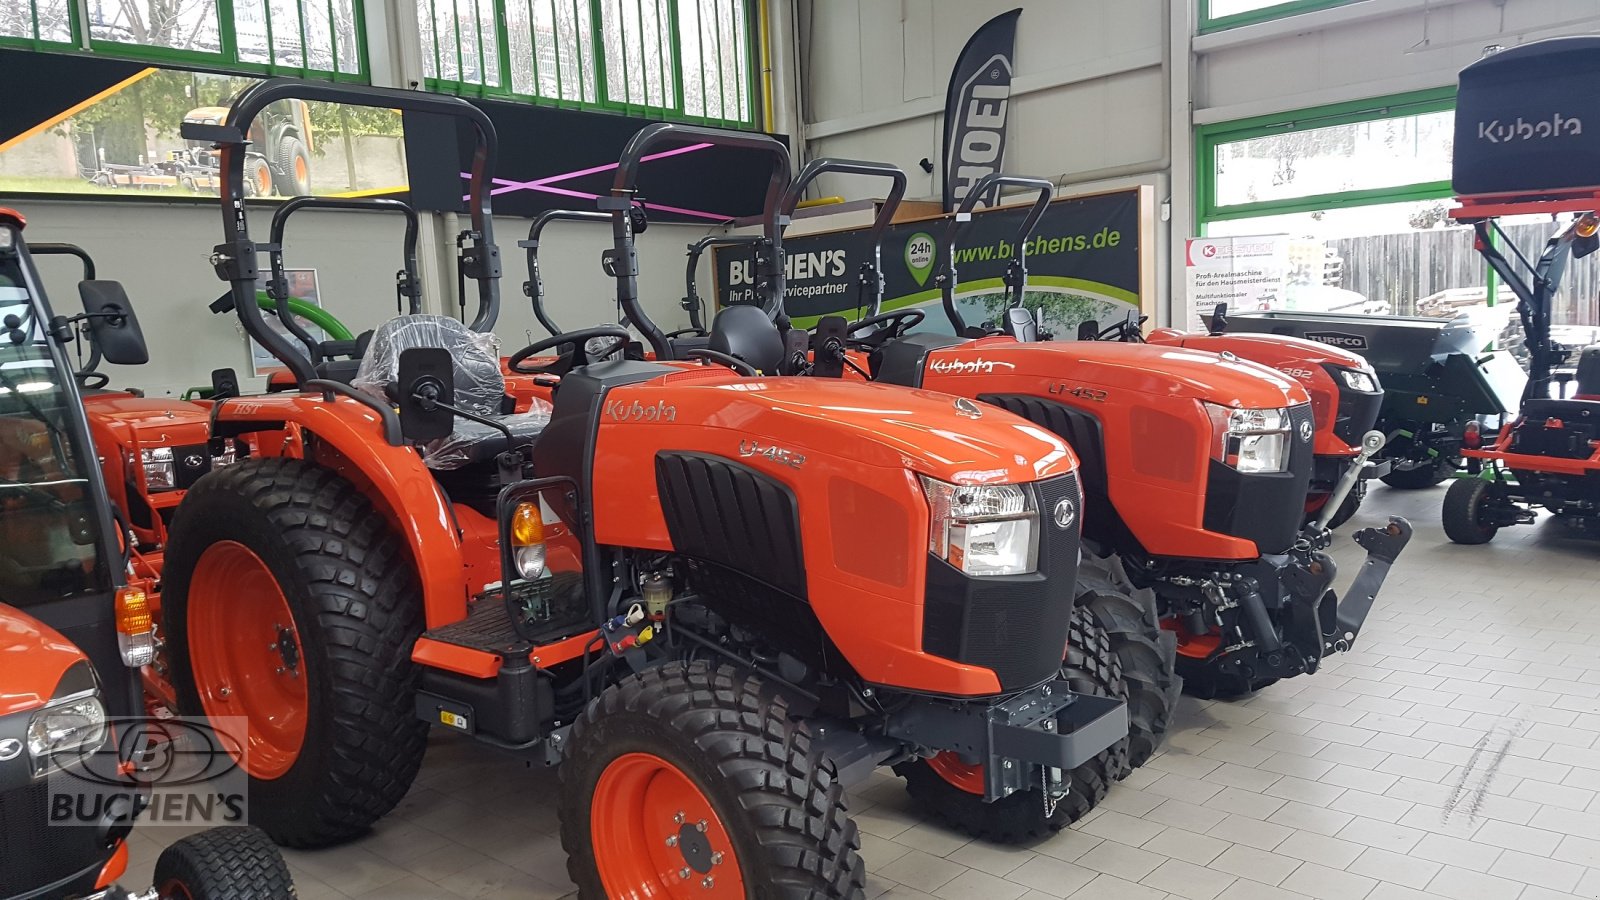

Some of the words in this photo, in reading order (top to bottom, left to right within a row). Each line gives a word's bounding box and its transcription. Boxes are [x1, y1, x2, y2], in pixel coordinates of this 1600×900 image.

[1478, 112, 1582, 143] Kubota
[953, 84, 1011, 212] HOEI
[910, 242, 931, 255] 24h
[953, 226, 1121, 264] www.bchens.de
[729, 249, 846, 285] BUHEN'S
[911, 256, 929, 264] online
[1196, 270, 1262, 279] Profi-Arealmaschine
[1220, 277, 1281, 285] Hausmeisterdienst
[729, 290, 742, 302] Ihr
[929, 357, 994, 374] Kubota
[233, 403, 262, 415] HST
[605, 399, 677, 421] Kubota
